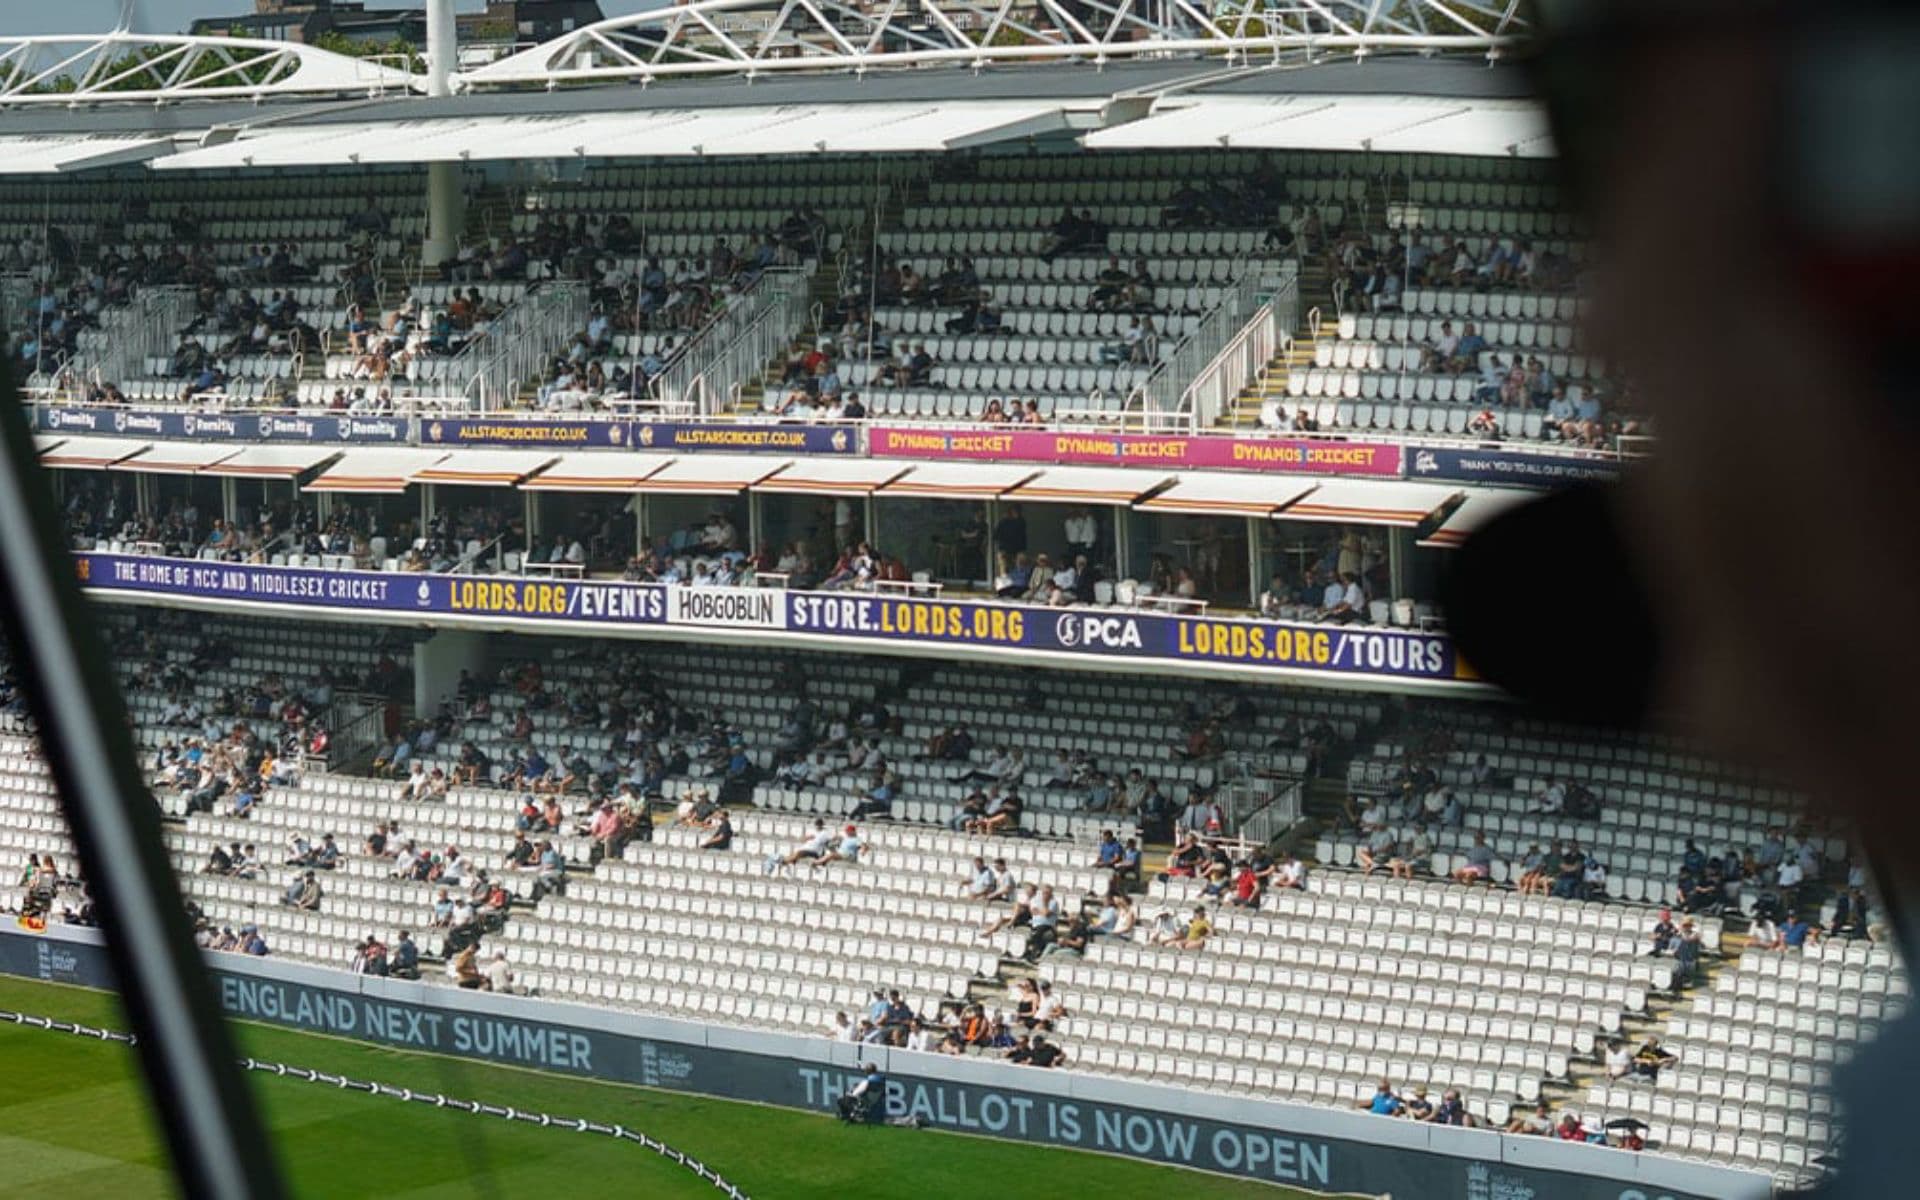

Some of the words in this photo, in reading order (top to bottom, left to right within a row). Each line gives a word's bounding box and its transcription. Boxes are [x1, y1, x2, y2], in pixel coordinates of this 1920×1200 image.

[459, 425, 588, 441] ALLSTARSCRICKET.CO.UK
[674, 429, 806, 446] ALLSTARSCRICKET.CO.UK
[888, 432, 947, 450] DYNAMOS
[951, 435, 1013, 452] CRICKET
[1057, 437, 1117, 455] DYNAMOS
[1122, 440, 1188, 458] CRICKET
[1233, 444, 1302, 461] DYNAMOS
[1306, 447, 1376, 465] CRICKET
[1493, 460, 1512, 472] YOU
[114, 561, 137, 581] THE
[139, 564, 171, 585] HOME
[174, 568, 189, 585] OF
[194, 568, 218, 588] MCC
[222, 570, 246, 591] AND
[252, 572, 325, 596] MIDDLESEX
[329, 578, 387, 600] CRICKET
[451, 581, 662, 619] LORDS.ORG/EVENTS
[679, 590, 773, 622] HOBGOBLIN
[793, 597, 1024, 641] STORE.LORDS.ORG
[1082, 618, 1142, 648] PCA
[1179, 622, 1443, 671] LORDS.ORG/TOURS
[222, 978, 356, 1031] ENGLAND
[364, 1005, 442, 1045] NEXT
[454, 1017, 592, 1069] SUMMER
[886, 1082, 1033, 1134] BALLOT
[1047, 1101, 1081, 1140] IS
[1094, 1110, 1200, 1160] NOW
[1211, 1130, 1329, 1185] OPEN
